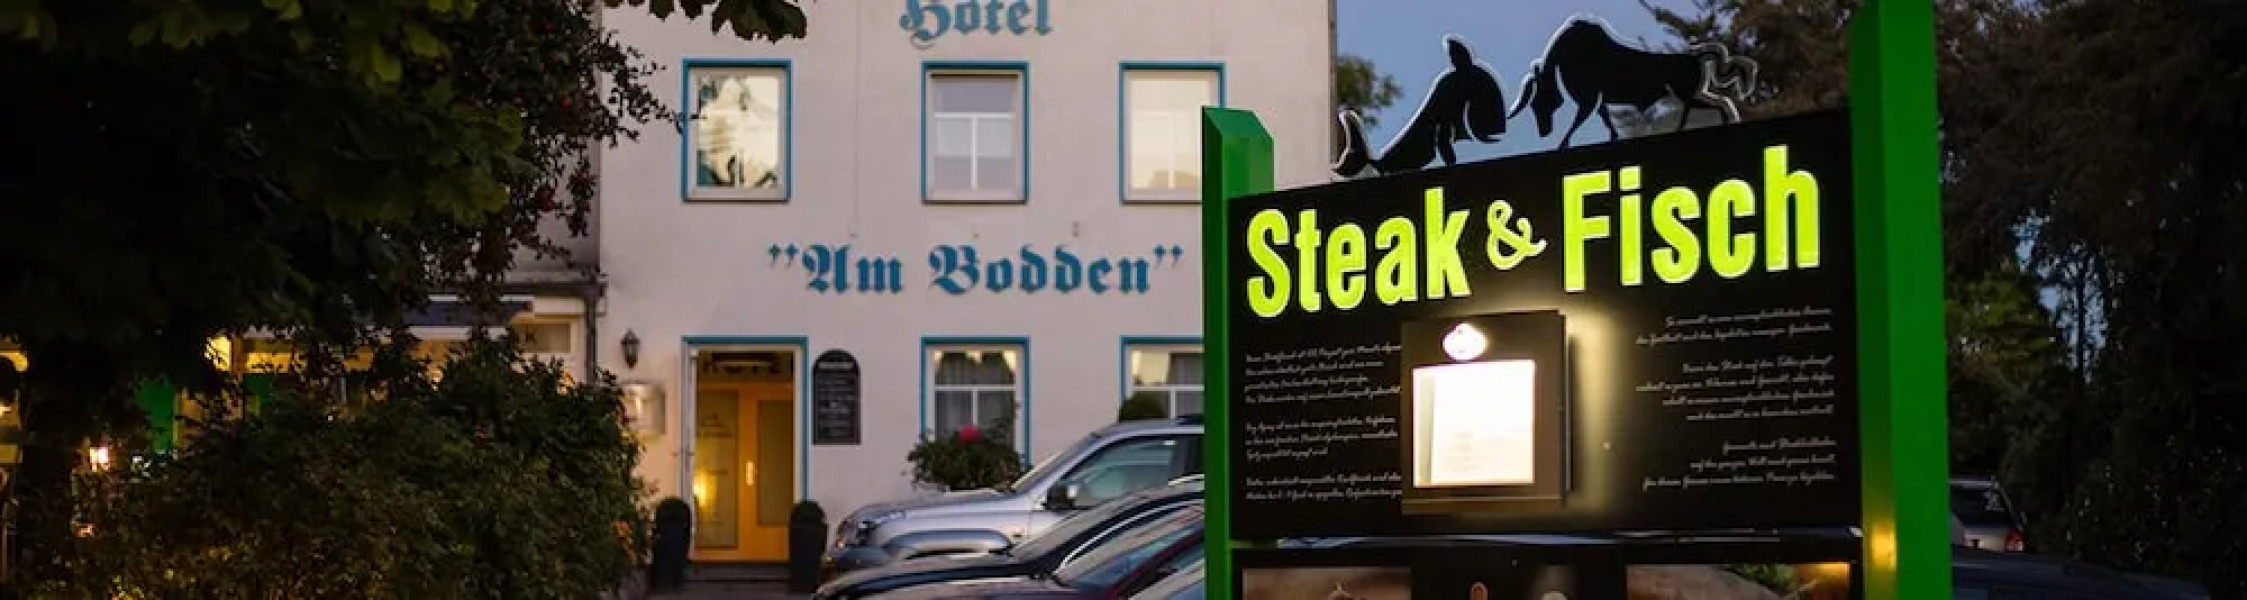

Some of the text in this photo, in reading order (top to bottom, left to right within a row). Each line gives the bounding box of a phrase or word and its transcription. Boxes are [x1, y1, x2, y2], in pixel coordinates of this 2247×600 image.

[899, 0, 1053, 48] Hotel
[1245, 145, 1820, 317] Steak & Fisch
